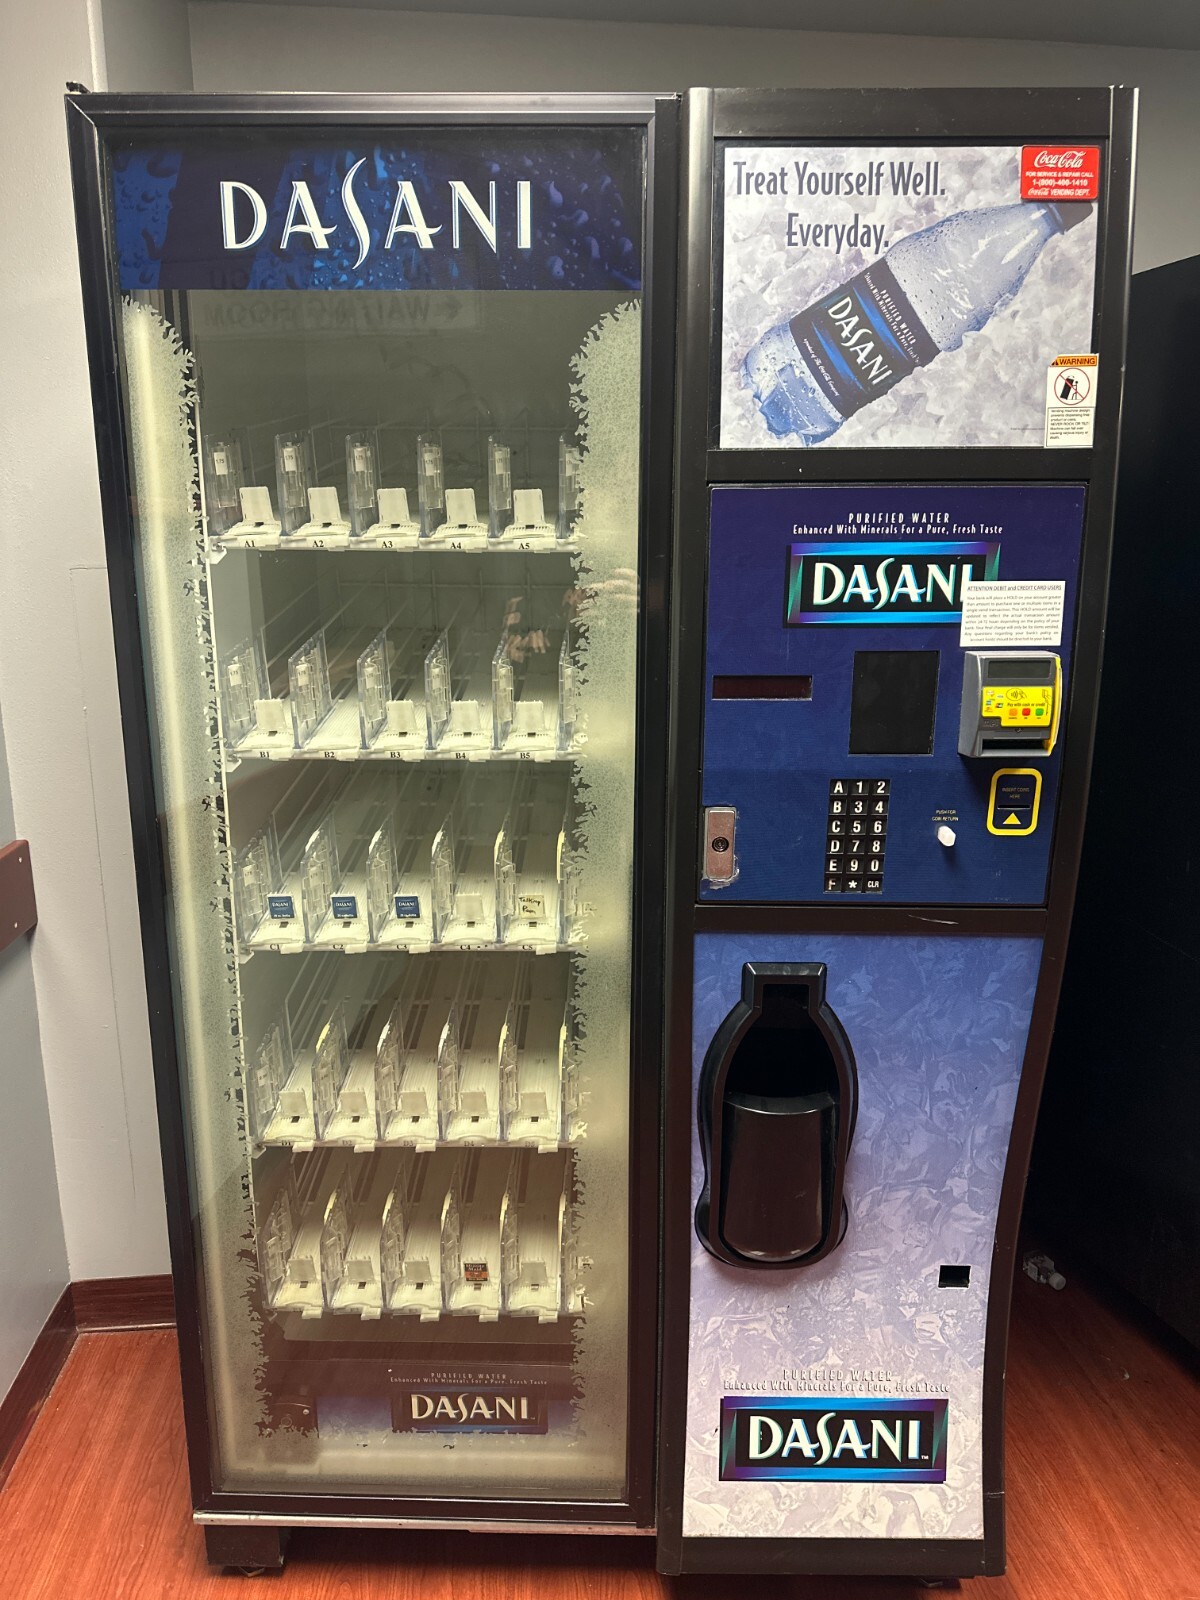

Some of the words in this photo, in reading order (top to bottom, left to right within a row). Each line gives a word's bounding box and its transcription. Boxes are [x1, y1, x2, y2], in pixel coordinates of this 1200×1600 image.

[733, 162, 788, 196] Treat
[794, 162, 884, 196] Yourself
[890, 162, 946, 196] Well.
[220, 156, 532, 270] DASANI
[786, 212, 890, 254] Everyday.
[880, 290, 902, 322] PURIFIED
[900, 322, 916, 345] WATER
[828, 296, 892, 385] DASANI
[849, 513, 904, 524] PURIFIED
[912, 513, 950, 523] WATER
[793, 525, 833, 535] Enhanced
[837, 525, 857, 534] With
[860, 525, 898, 534] Minerals
[902, 525, 915, 534] For
[927, 525, 949, 535] Pure,
[953, 524, 976, 534] Fresh
[980, 524, 1003, 534] Taste
[813, 558, 973, 610] DASANI
[834, 781, 843, 794] A
[856, 781, 863, 793] 1
[877, 781, 885, 793] 2
[833, 801, 841, 813] B
[855, 801, 862, 813] 3
[875, 801, 884, 813] 4
[832, 820, 840, 832] C
[853, 820, 861, 832] 5
[874, 820, 882, 832] 6
[830, 840, 840, 852] D
[852, 840, 860, 852] 7
[872, 840, 880, 852] 8
[829, 859, 837, 871] E
[850, 859, 858, 871] 9
[871, 859, 879, 871] 0
[828, 880, 836, 890] F
[783, 1369, 844, 1381] PURIFIED
[852, 1370, 892, 1381] WATER
[724, 1380, 766, 1390] Enhanced
[771, 1381, 793, 1390] With
[797, 1381, 836, 1391] Minerals
[841, 1382, 856, 1391] For
[868, 1382, 892, 1393] Pure,
[896, 1383, 920, 1392] Fresh
[924, 1383, 949, 1393] Taste
[411, 1393, 528, 1423] DASANI
[749, 1412, 920, 1465] DASANI
